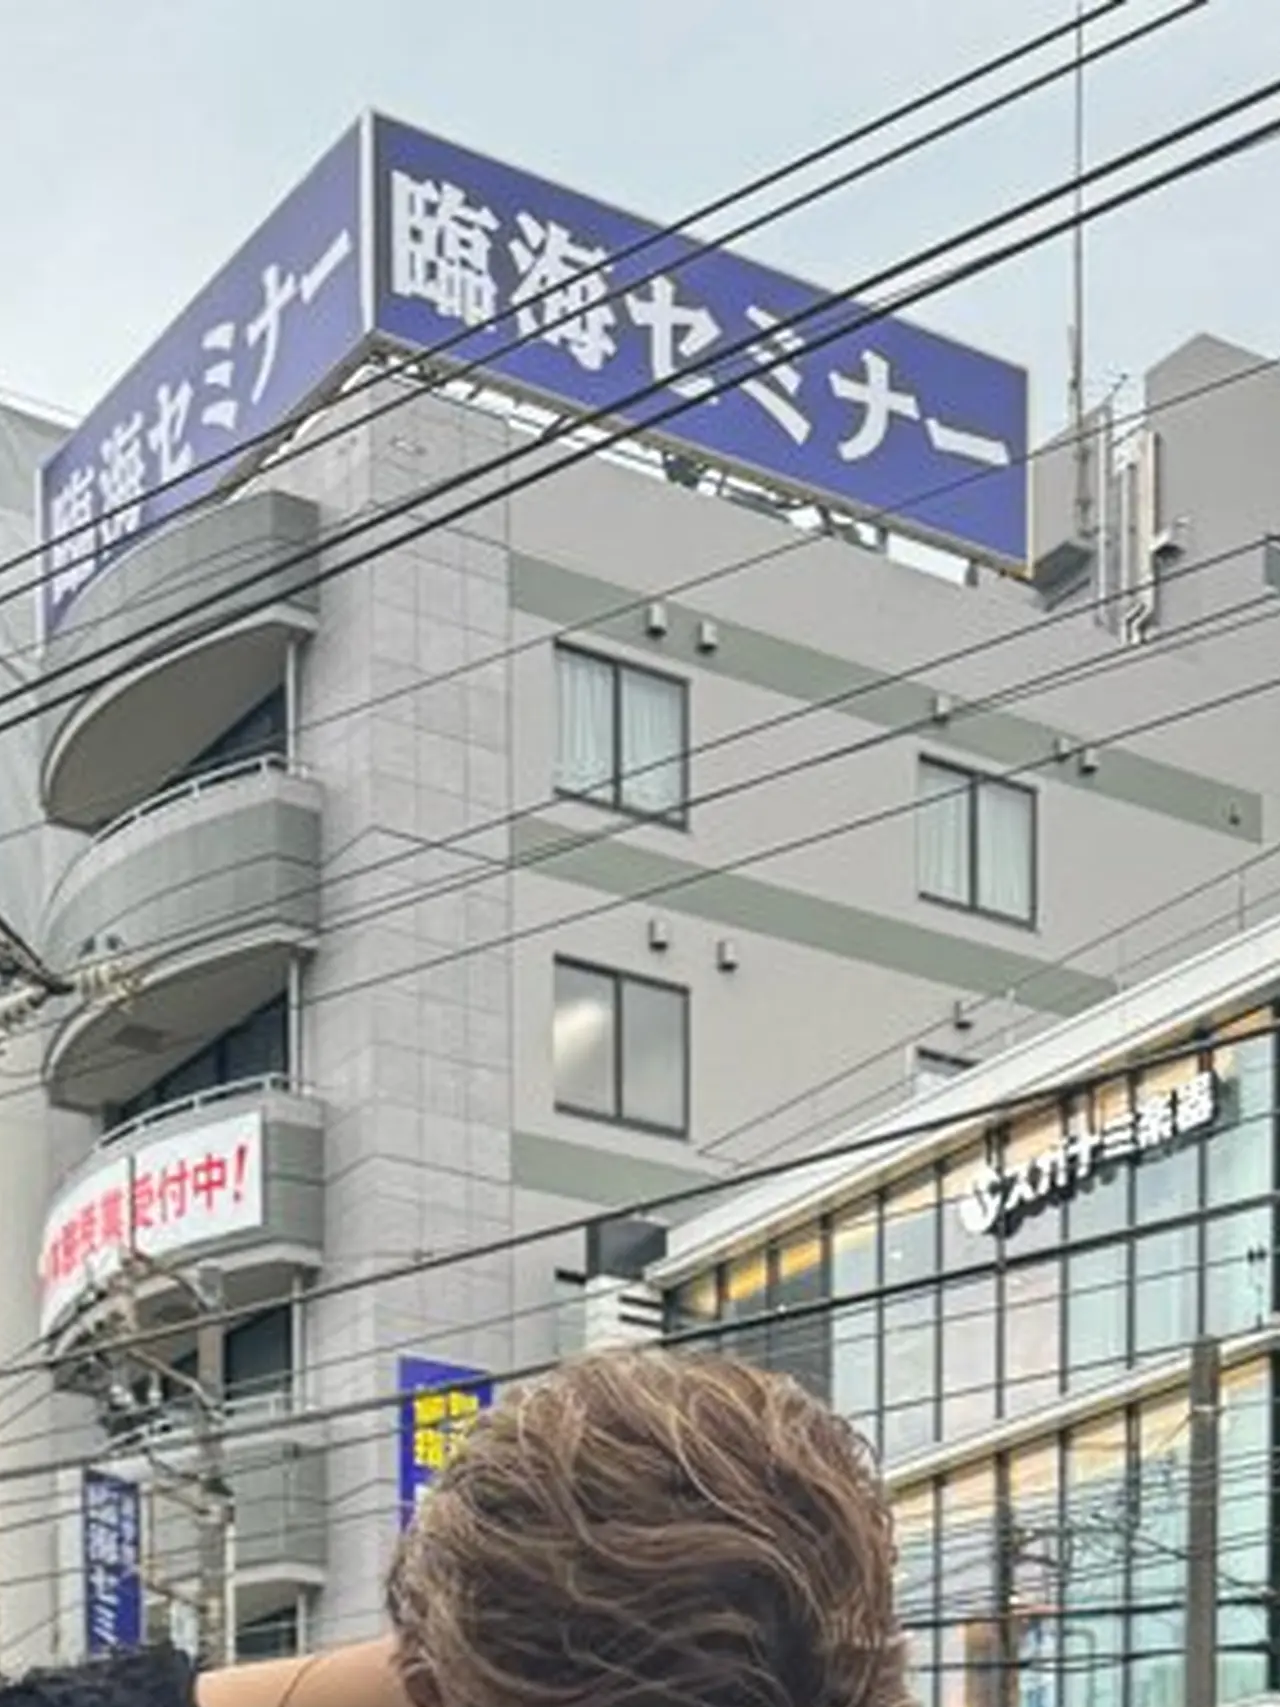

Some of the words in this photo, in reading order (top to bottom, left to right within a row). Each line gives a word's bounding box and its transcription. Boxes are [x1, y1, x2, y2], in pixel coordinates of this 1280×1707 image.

[52, 229, 353, 605] 臨海セミナー
[389, 168, 1011, 467] 臨海セミナー
